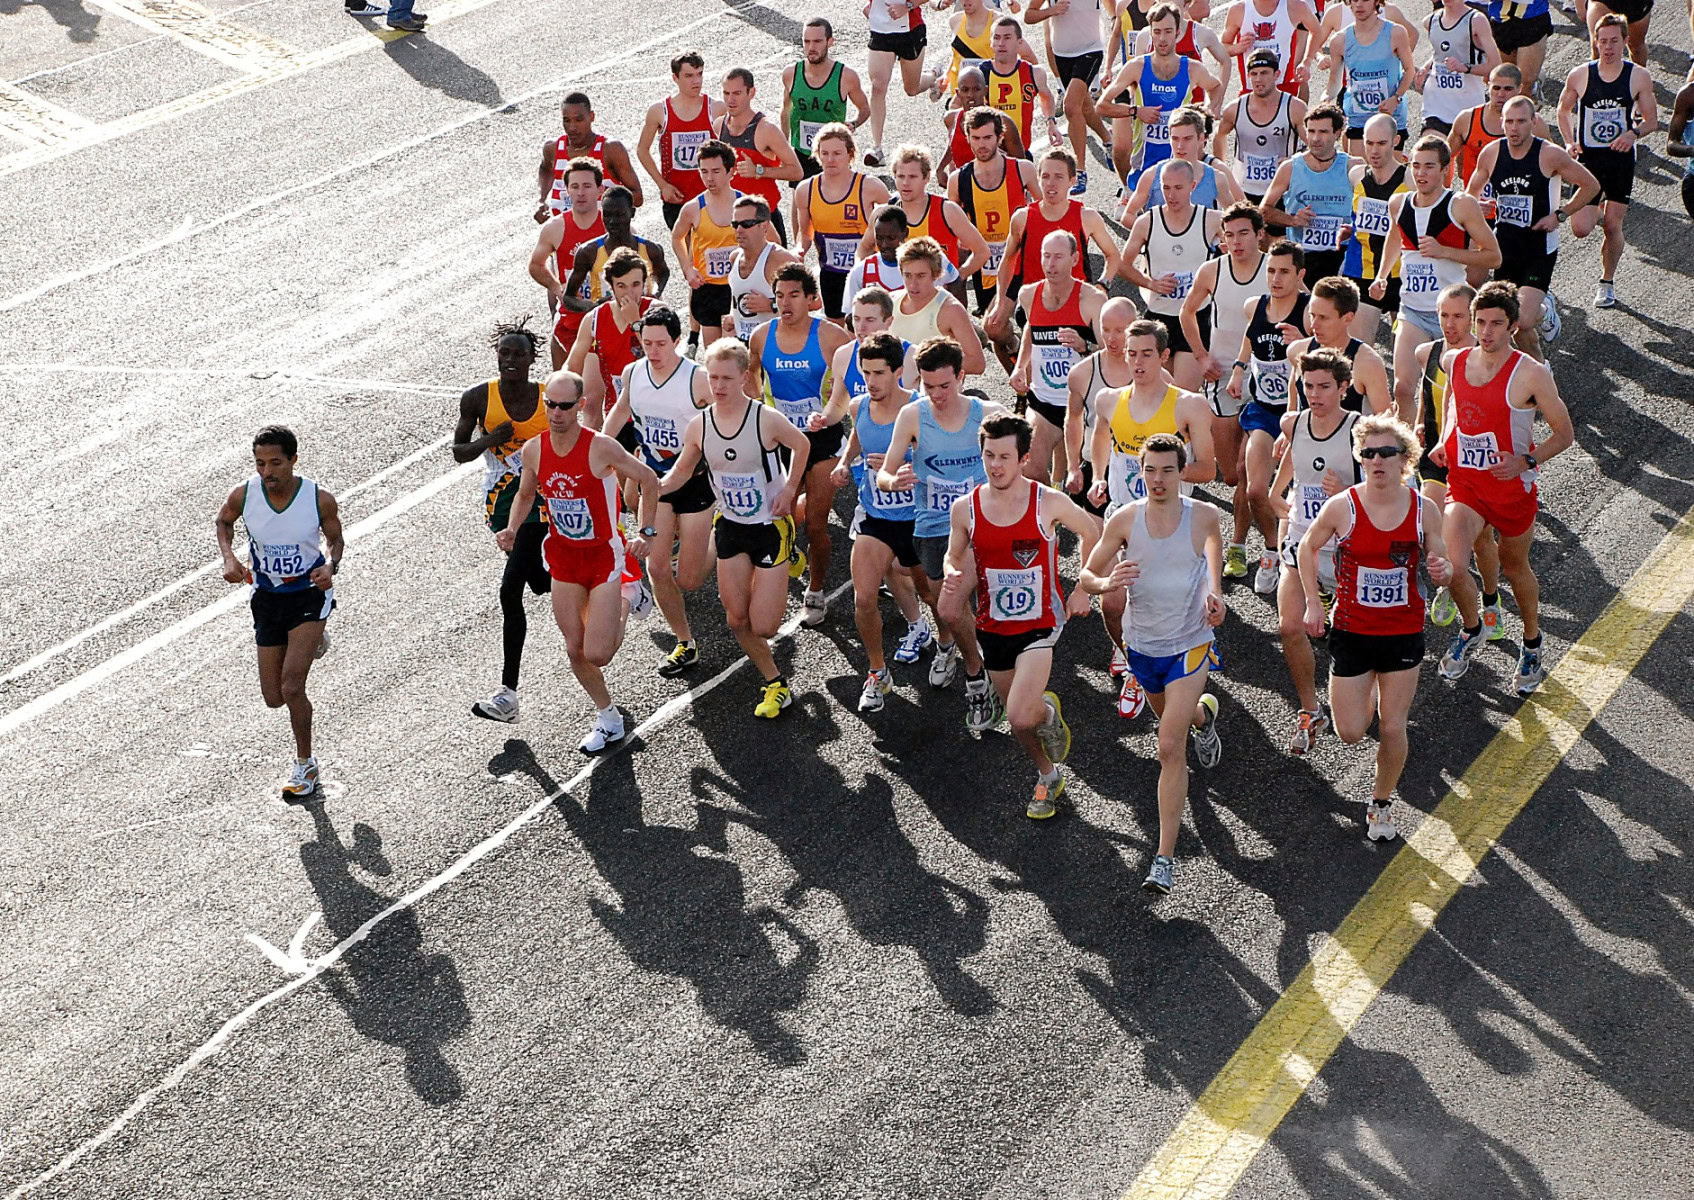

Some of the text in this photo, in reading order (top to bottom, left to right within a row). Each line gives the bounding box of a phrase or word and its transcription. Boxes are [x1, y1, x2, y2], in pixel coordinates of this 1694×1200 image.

[998, 83, 1013, 103] P
[1023, 84, 1034, 102] S
[1152, 83, 1177, 92] knox
[1360, 91, 1380, 105] 106
[1273, 127, 1285, 136] 21
[1599, 125, 1615, 138] 29
[1247, 166, 1276, 180] 1936
[1500, 176, 1530, 188] GEELONG
[984, 211, 1001, 233] P
[1357, 212, 1390, 232] 1279
[1500, 205, 1530, 223] 2220
[1304, 229, 1337, 246] 2301
[1405, 275, 1439, 292] 1872
[775, 358, 809, 369] knox
[1046, 361, 1070, 377] 406
[1265, 378, 1285, 393] 36
[645, 426, 679, 448] 1455
[553, 490, 574, 498] YCW
[727, 490, 754, 508] 111
[875, 488, 913, 505] 1319
[263, 555, 304, 574] 1452
[1006, 592, 1027, 610] 19
[1361, 585, 1404, 603] 1391
